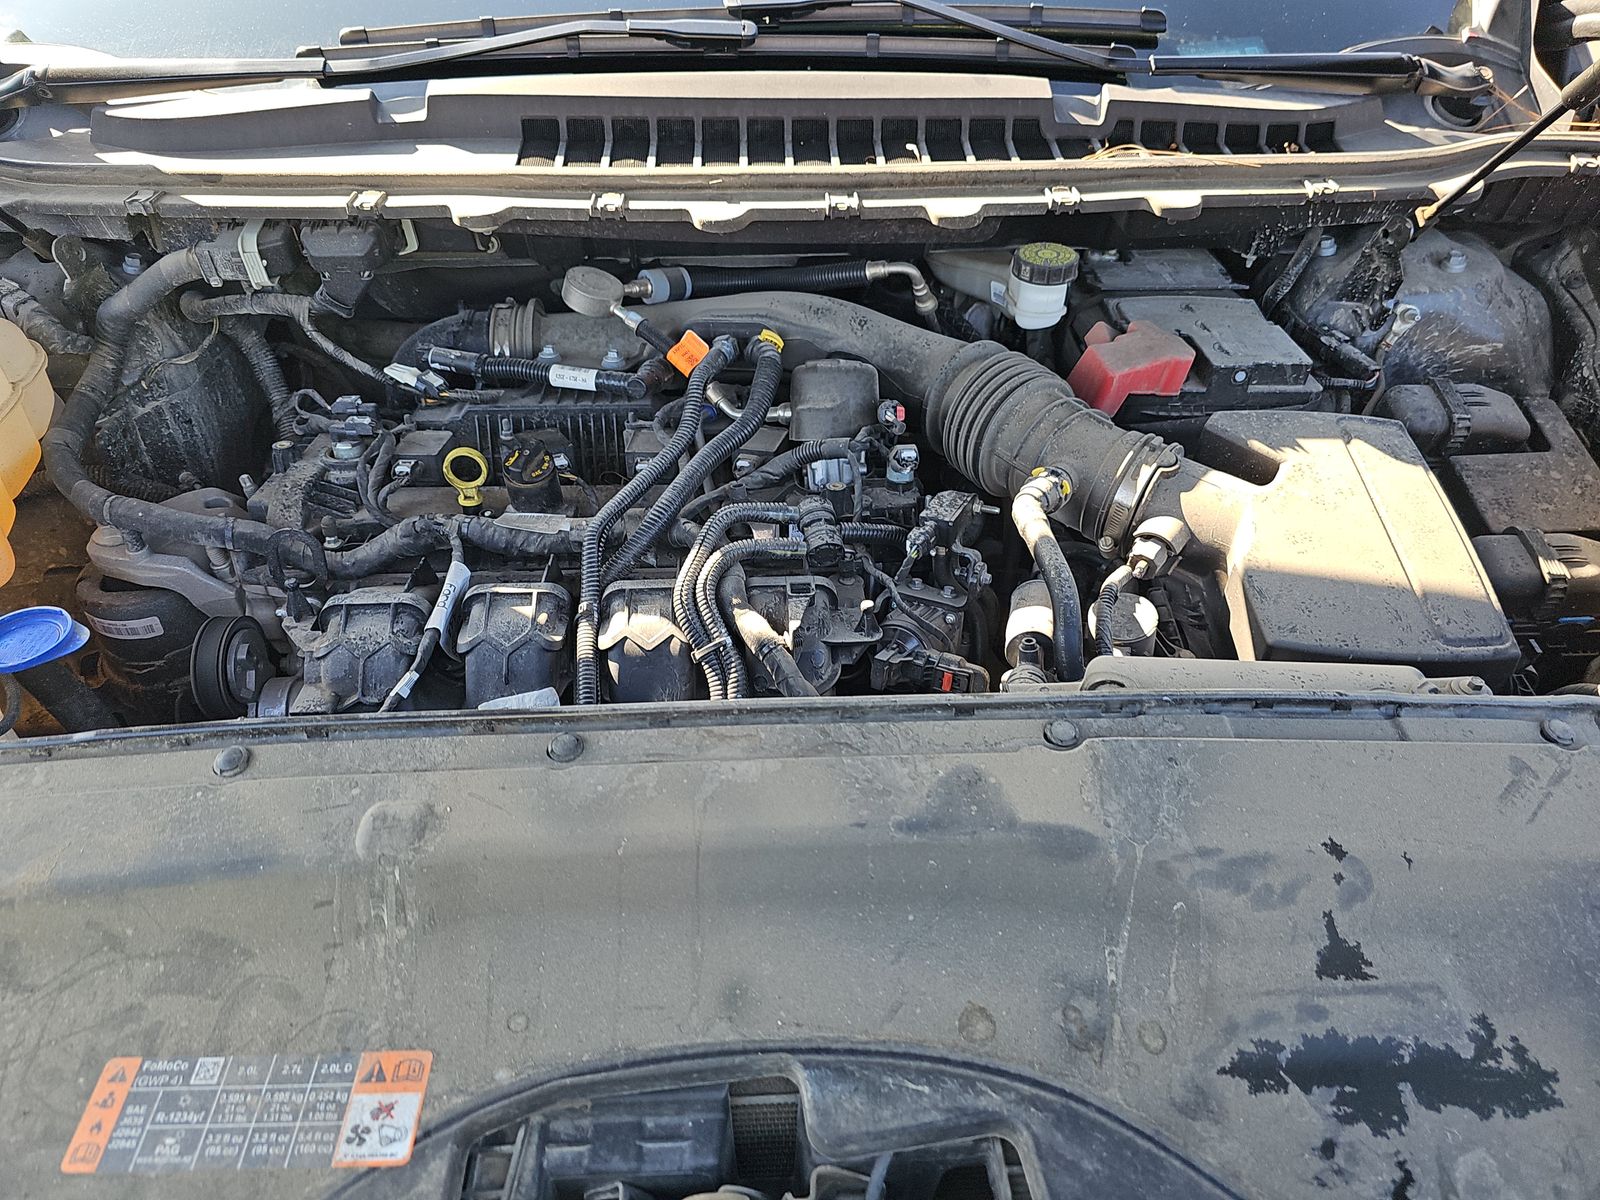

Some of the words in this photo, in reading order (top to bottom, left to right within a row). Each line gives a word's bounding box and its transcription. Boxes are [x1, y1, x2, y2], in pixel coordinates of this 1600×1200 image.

[142, 1060, 190, 1072] FoMoCo
[282, 1064, 303, 1075] 2.7L
[321, 1063, 342, 1074] 2.0L
[344, 1062, 353, 1073] D
[155, 1110, 206, 1124] R-1234yf
